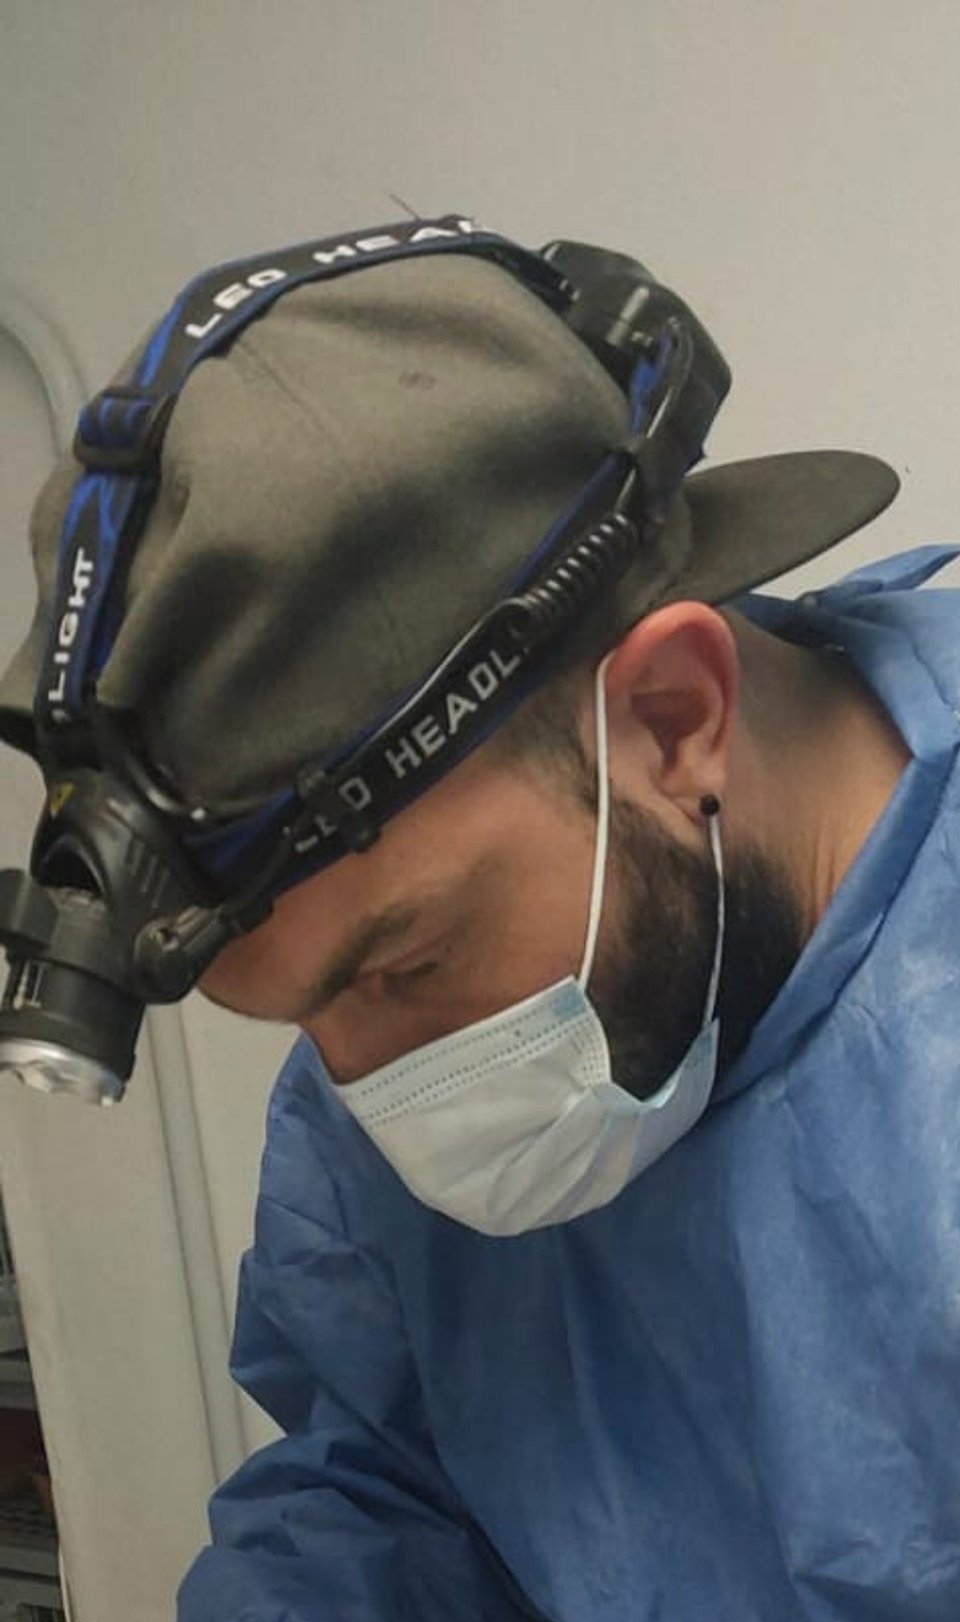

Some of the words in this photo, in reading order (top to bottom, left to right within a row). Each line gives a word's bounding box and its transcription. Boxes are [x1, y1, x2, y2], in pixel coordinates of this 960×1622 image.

[184, 268, 288, 339] LED
[48, 547, 94, 724] LIGHT
[384, 649, 529, 779] HEADL
